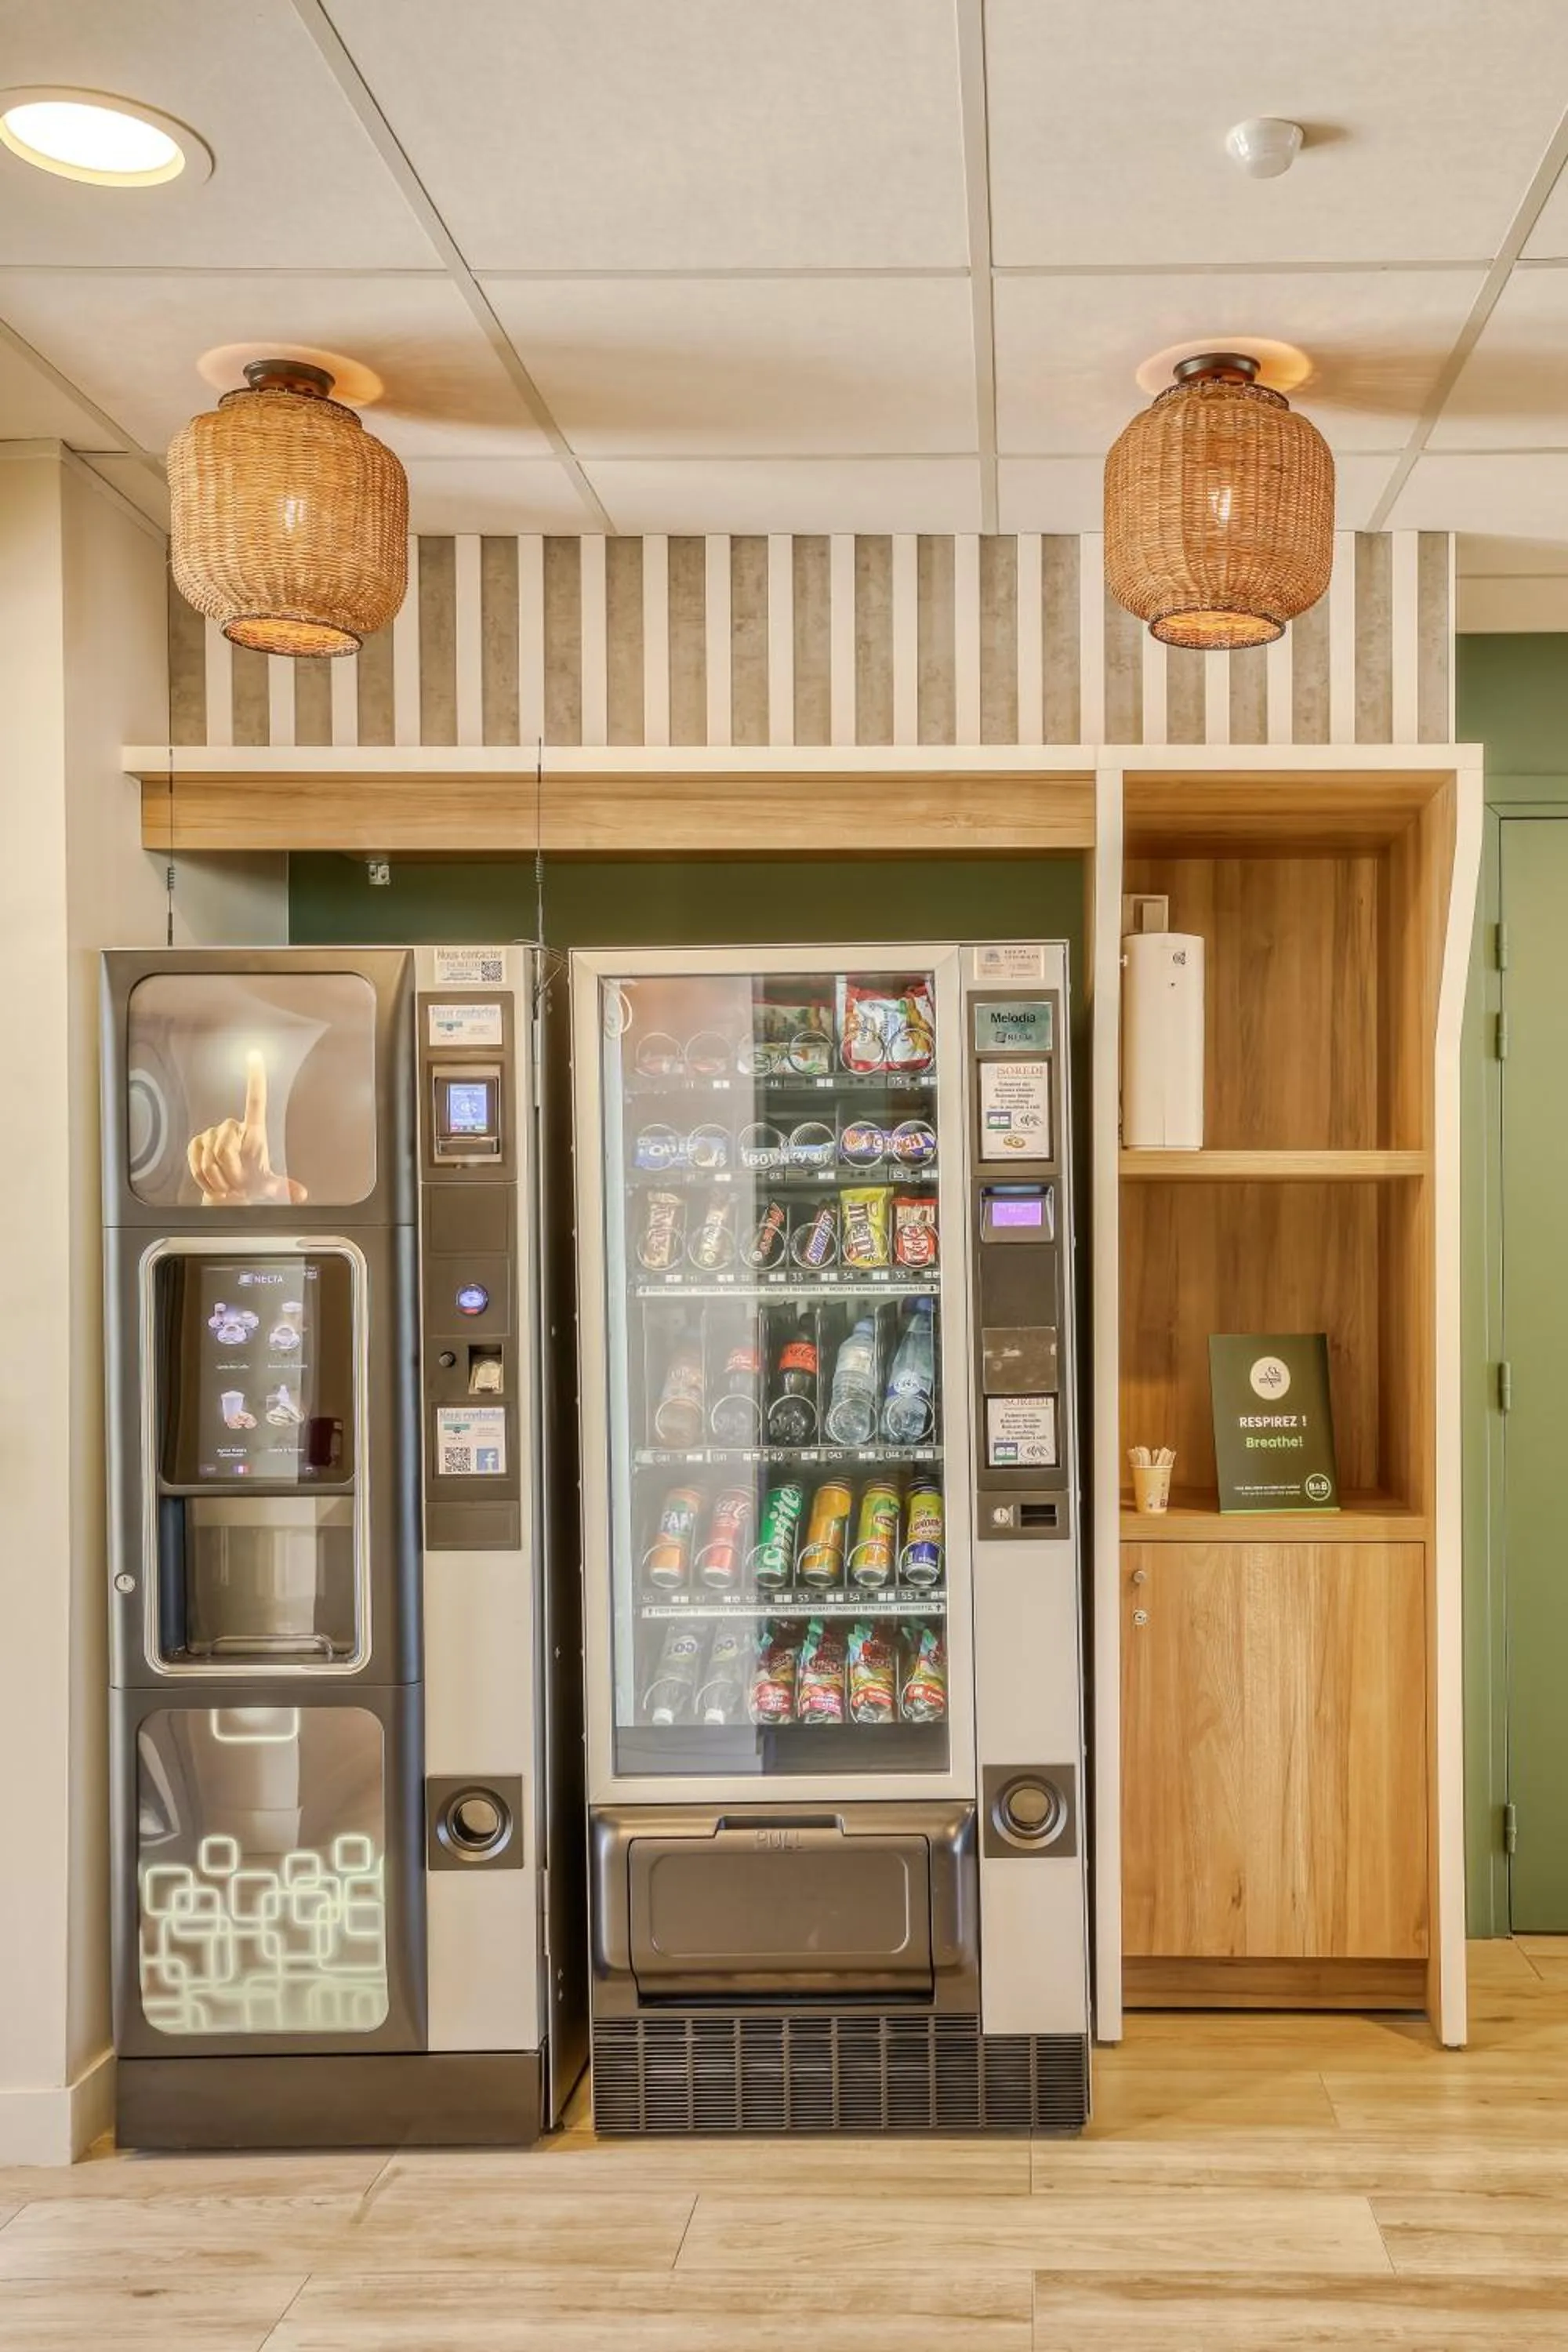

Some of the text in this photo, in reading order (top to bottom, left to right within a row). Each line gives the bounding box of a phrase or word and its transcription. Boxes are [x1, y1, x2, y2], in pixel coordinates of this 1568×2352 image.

[437, 949, 459, 960] Nous
[990, 1012, 1036, 1023] Melodia
[807, 1213, 836, 1265] SNICKERS
[254, 1275, 283, 1284] NECTA
[1239, 1416, 1298, 1428] RESPIREZ
[1245, 1436, 1303, 1448] Breathe!
[755, 1830, 804, 1850] PULL
